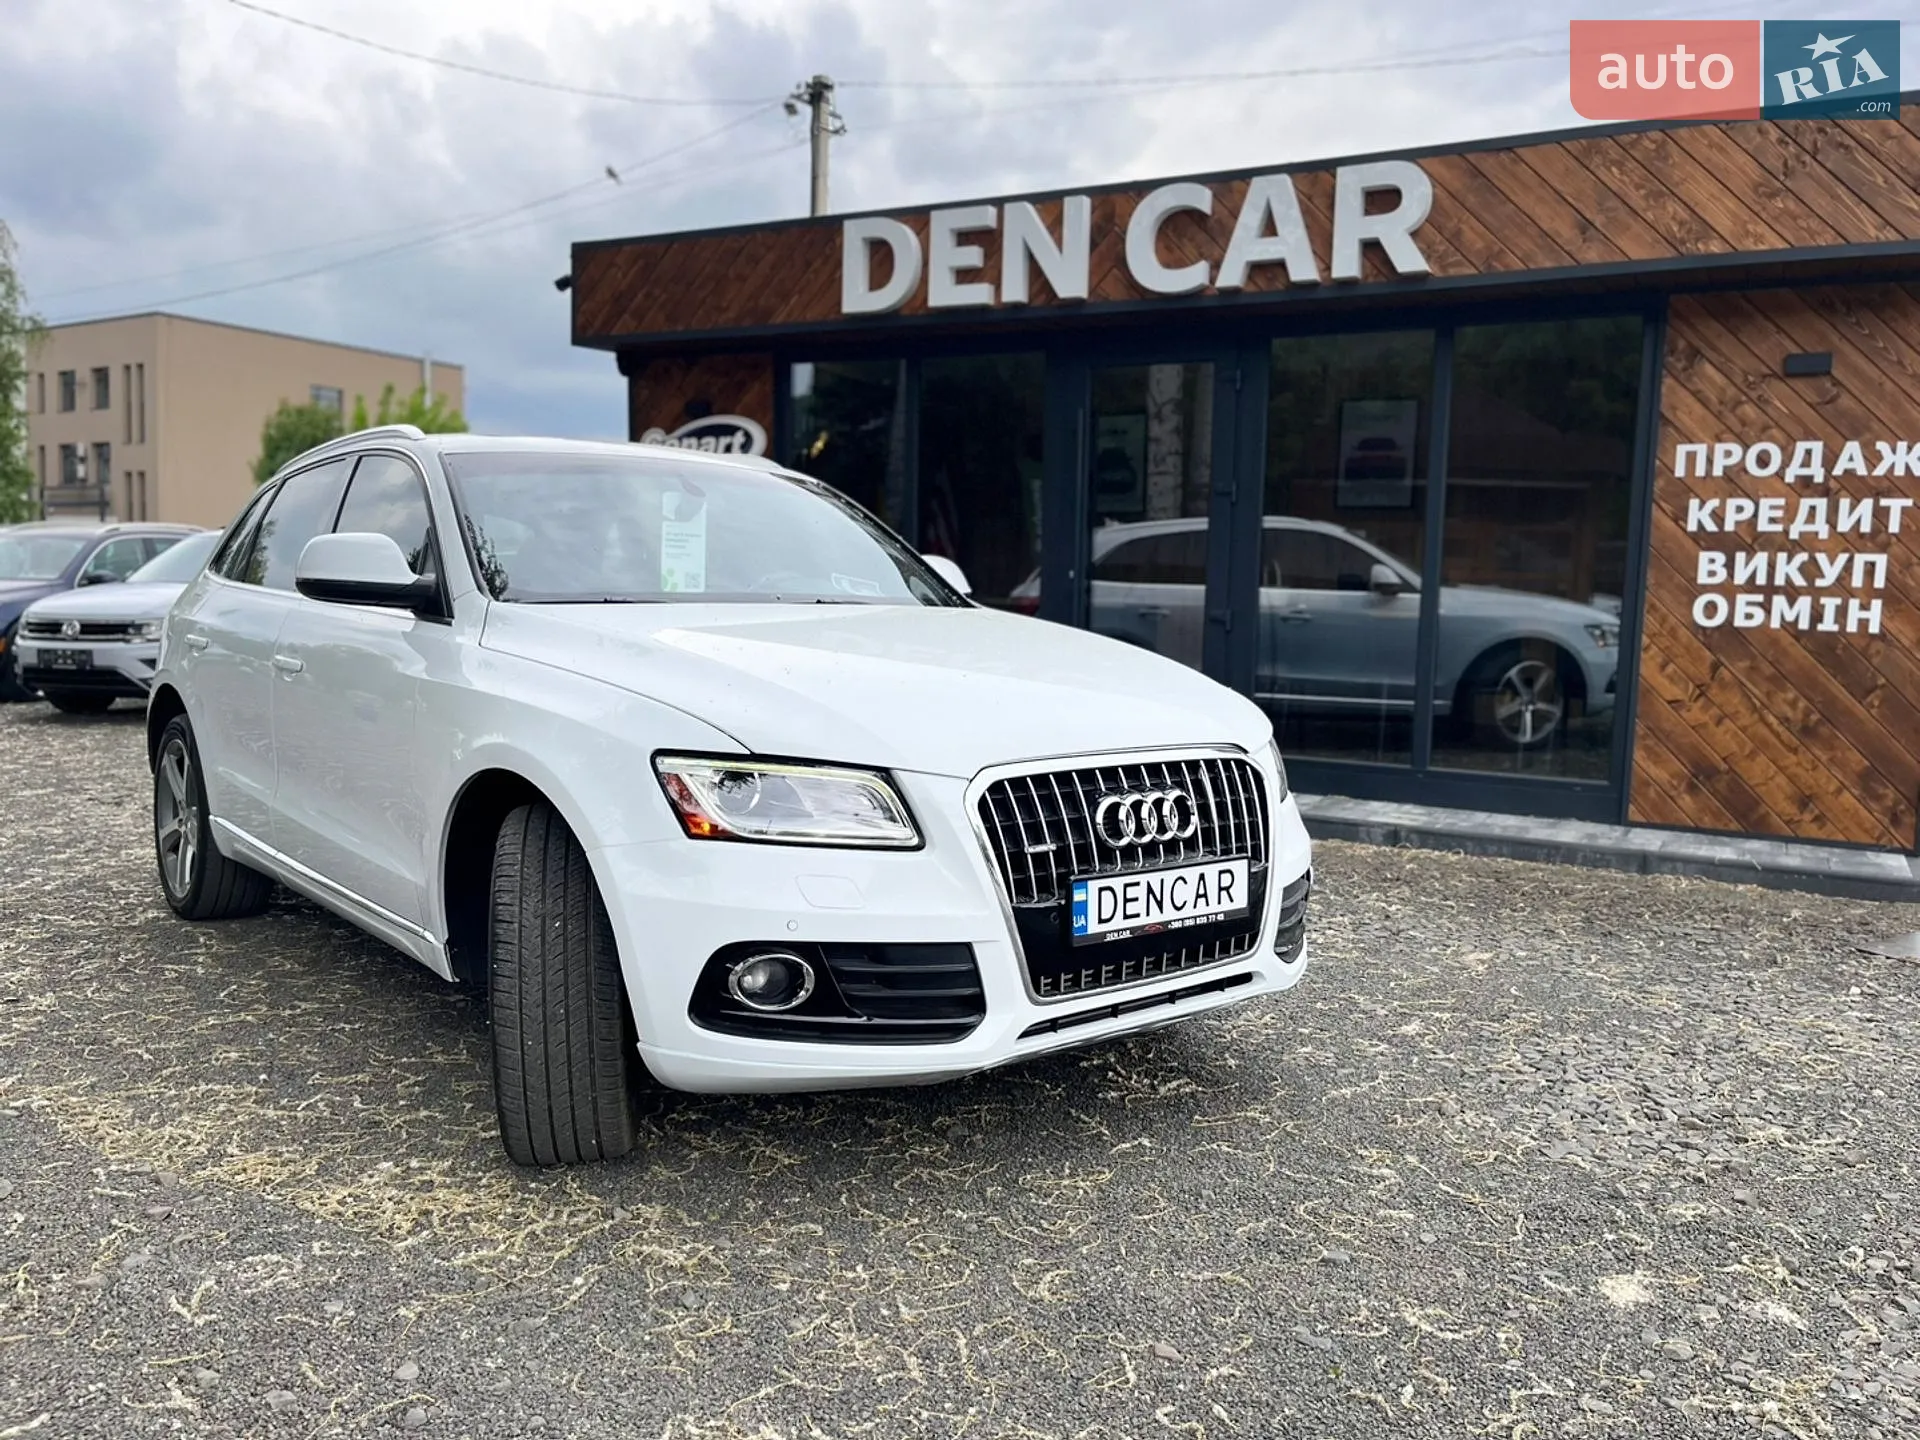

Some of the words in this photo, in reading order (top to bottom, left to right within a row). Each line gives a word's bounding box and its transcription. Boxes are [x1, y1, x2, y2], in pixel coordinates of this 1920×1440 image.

[841, 194, 1091, 314] DEN
[1125, 159, 1433, 295] CAR
[1674, 440, 1920, 483] ПРОДАЖ
[1686, 497, 1913, 540] КРЕДИТ
[1696, 551, 1888, 589] ВИКУП
[1692, 593, 1883, 634] ОБМІН
[1073, 914, 1086, 928] UA
[1098, 868, 1235, 925] DENCAR
